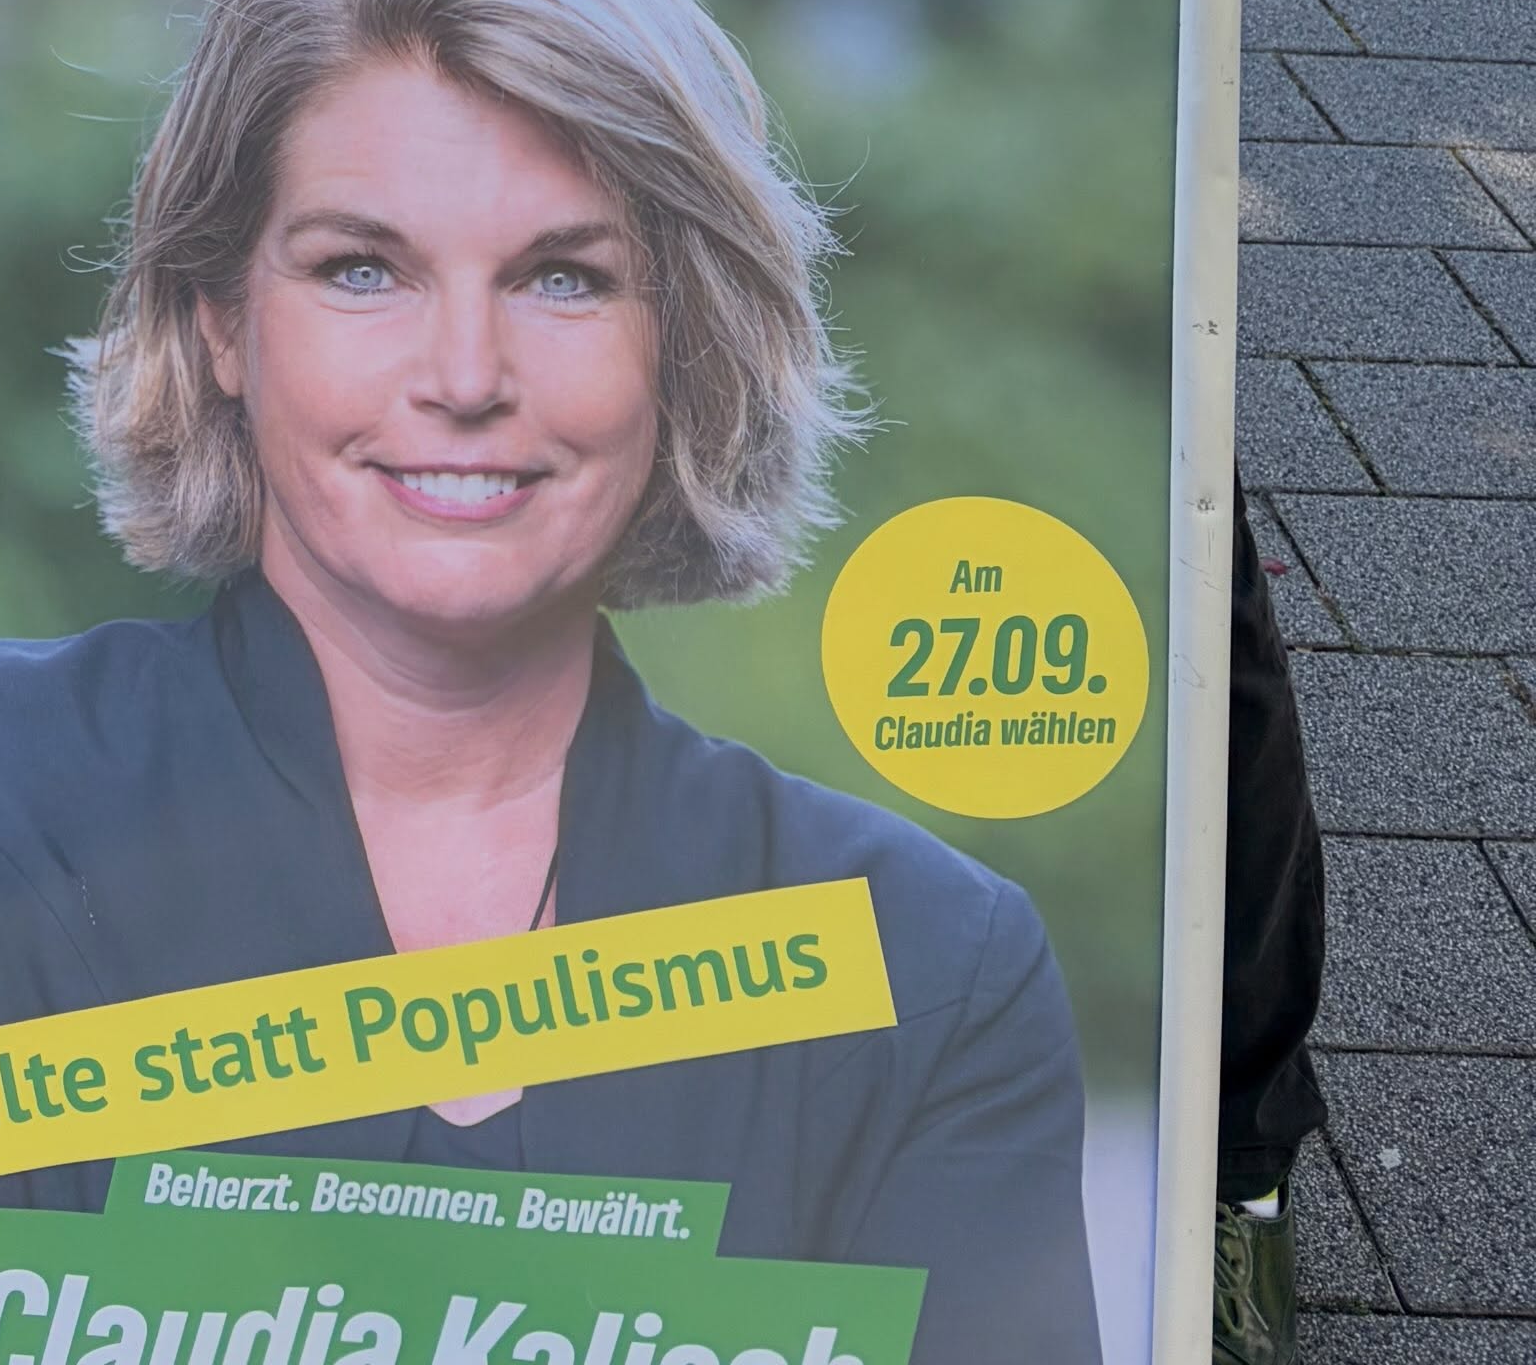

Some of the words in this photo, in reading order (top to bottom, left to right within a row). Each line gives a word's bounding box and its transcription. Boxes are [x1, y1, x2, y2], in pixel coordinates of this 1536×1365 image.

[949, 560, 1003, 594] Am
[887, 613, 1108, 698] 27.09.
[874, 710, 992, 751] Claudia
[1000, 711, 1116, 746] wählen
[136, 1008, 327, 1104] statt
[347, 929, 830, 1067] Populismus
[144, 1162, 301, 1212] Beherzt.
[311, 1172, 506, 1227] Besonnen.
[516, 1188, 691, 1240] Bewährt.
